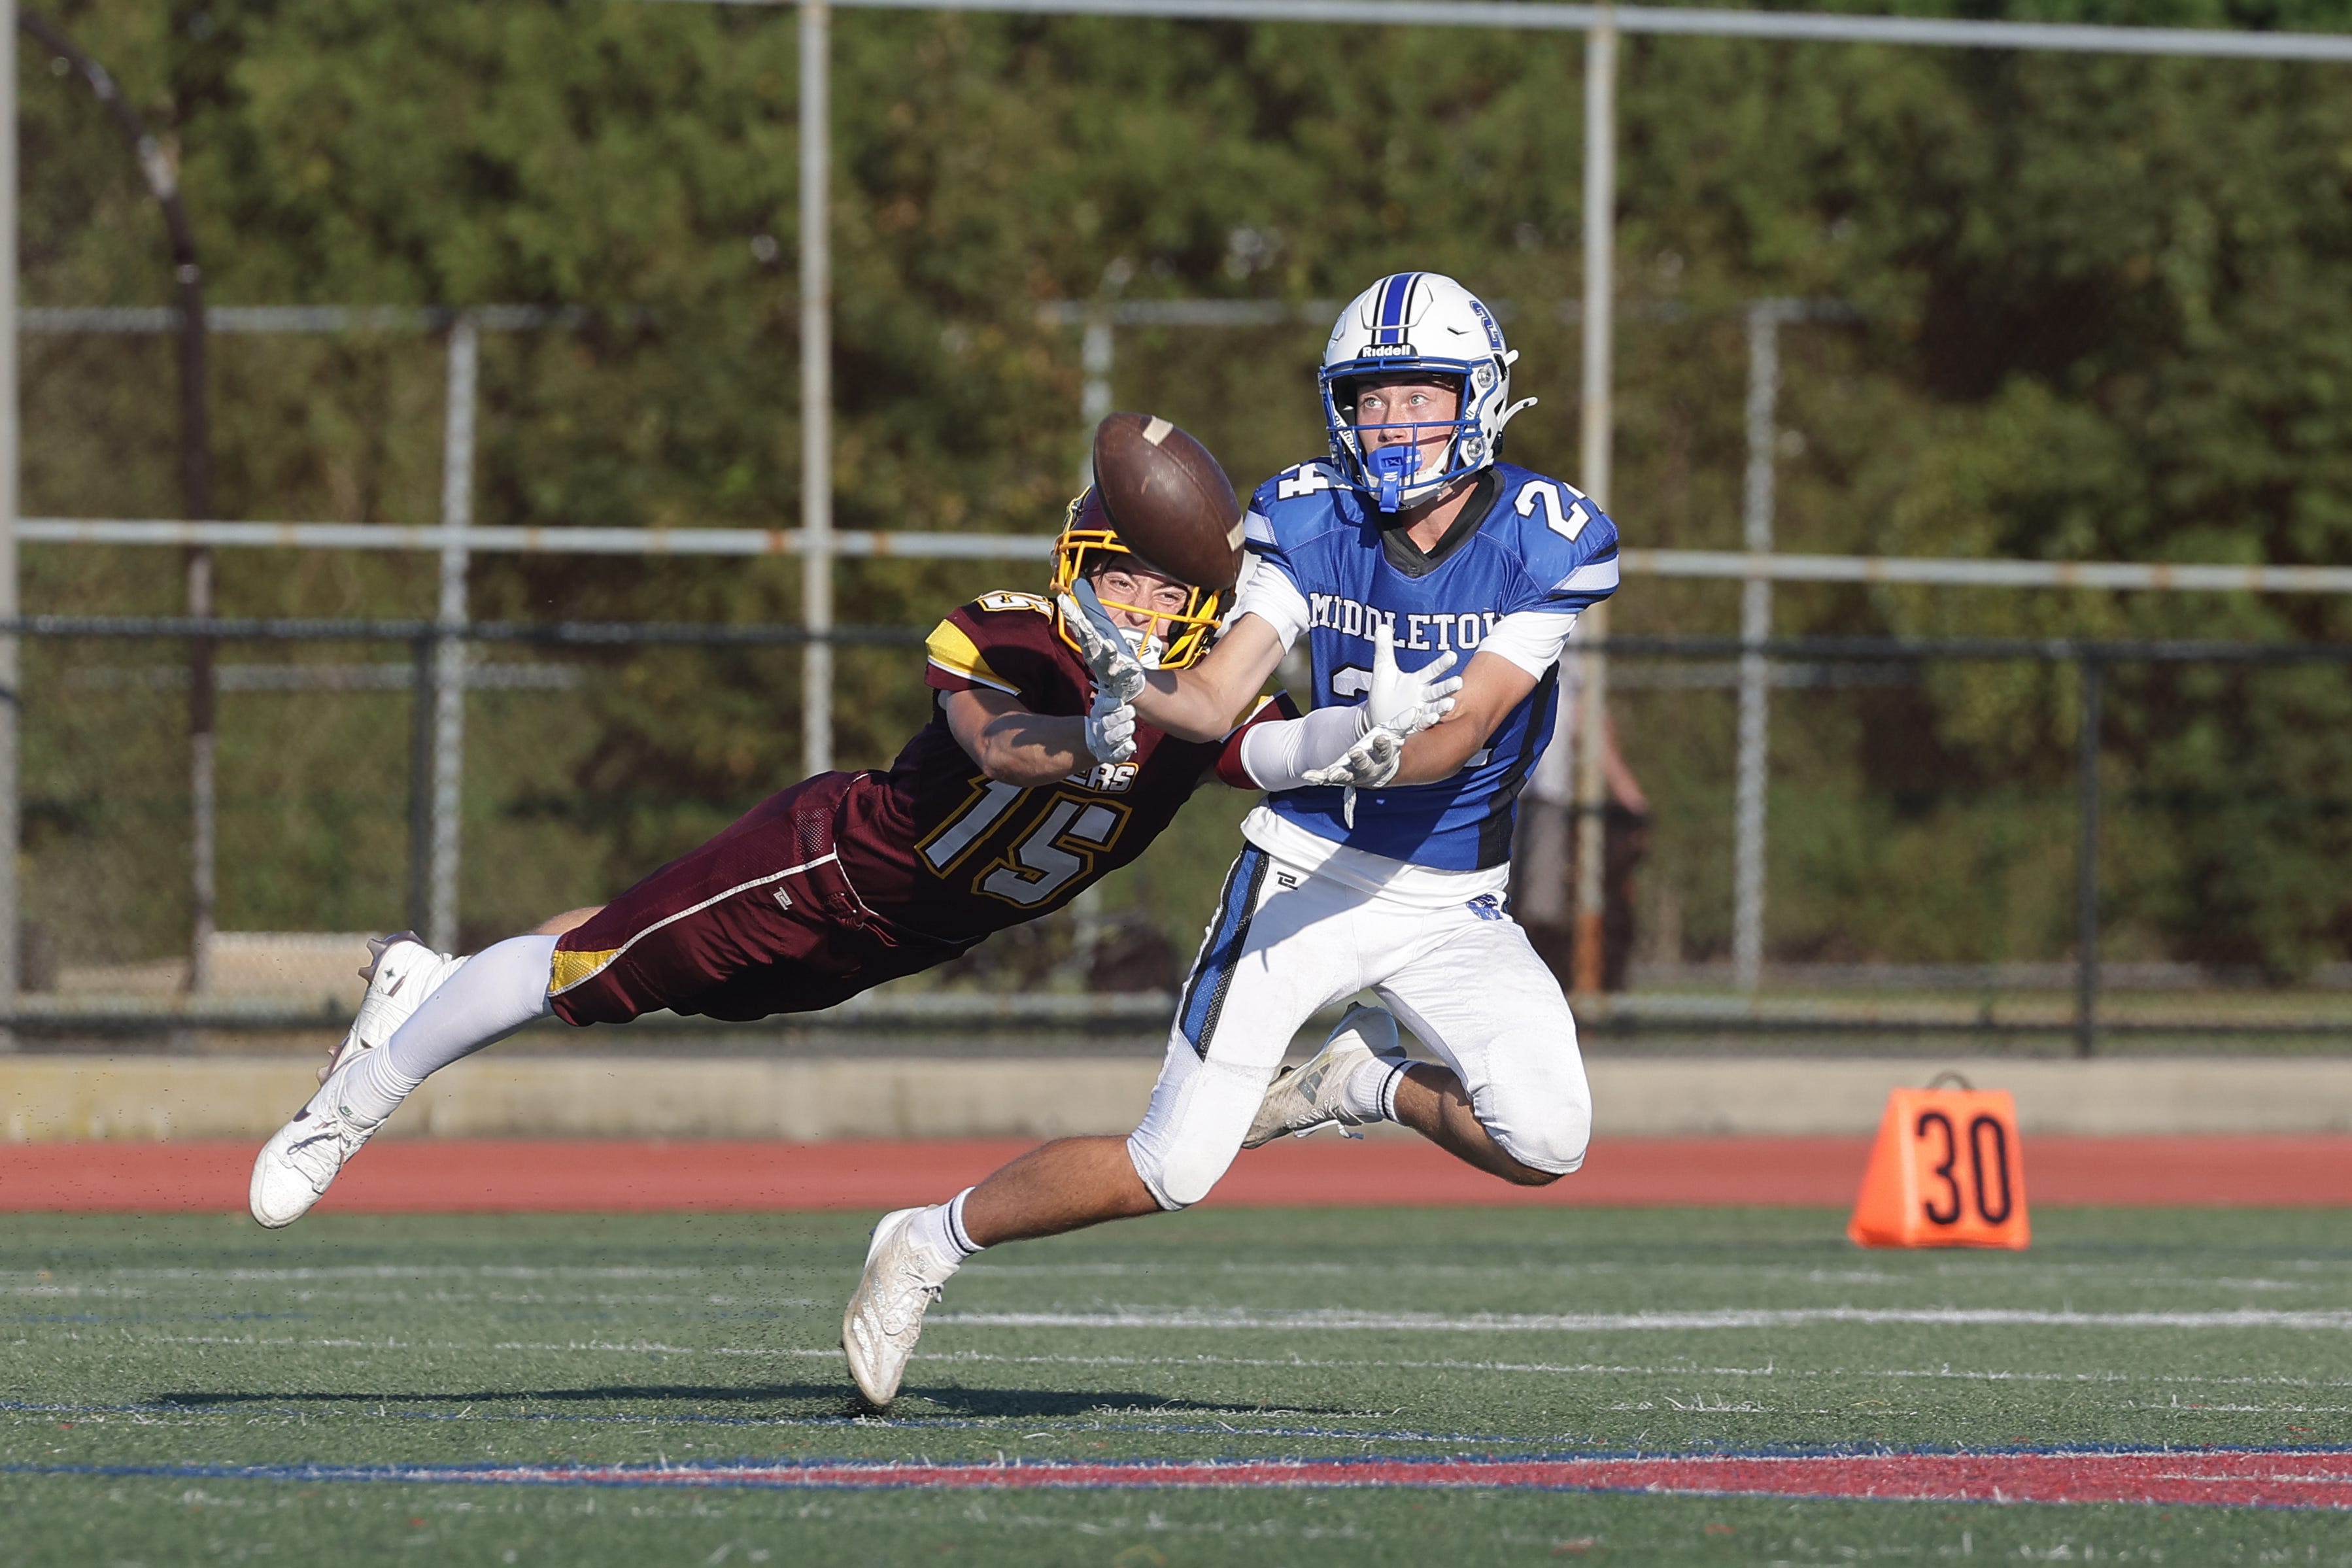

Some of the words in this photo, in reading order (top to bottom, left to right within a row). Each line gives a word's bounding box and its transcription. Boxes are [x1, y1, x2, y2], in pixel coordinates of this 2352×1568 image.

[1362, 345, 1410, 358] Riddell
[1513, 479, 1604, 544] 2
[914, 774, 1133, 909] 15
[1918, 1114, 2011, 1225] 30
